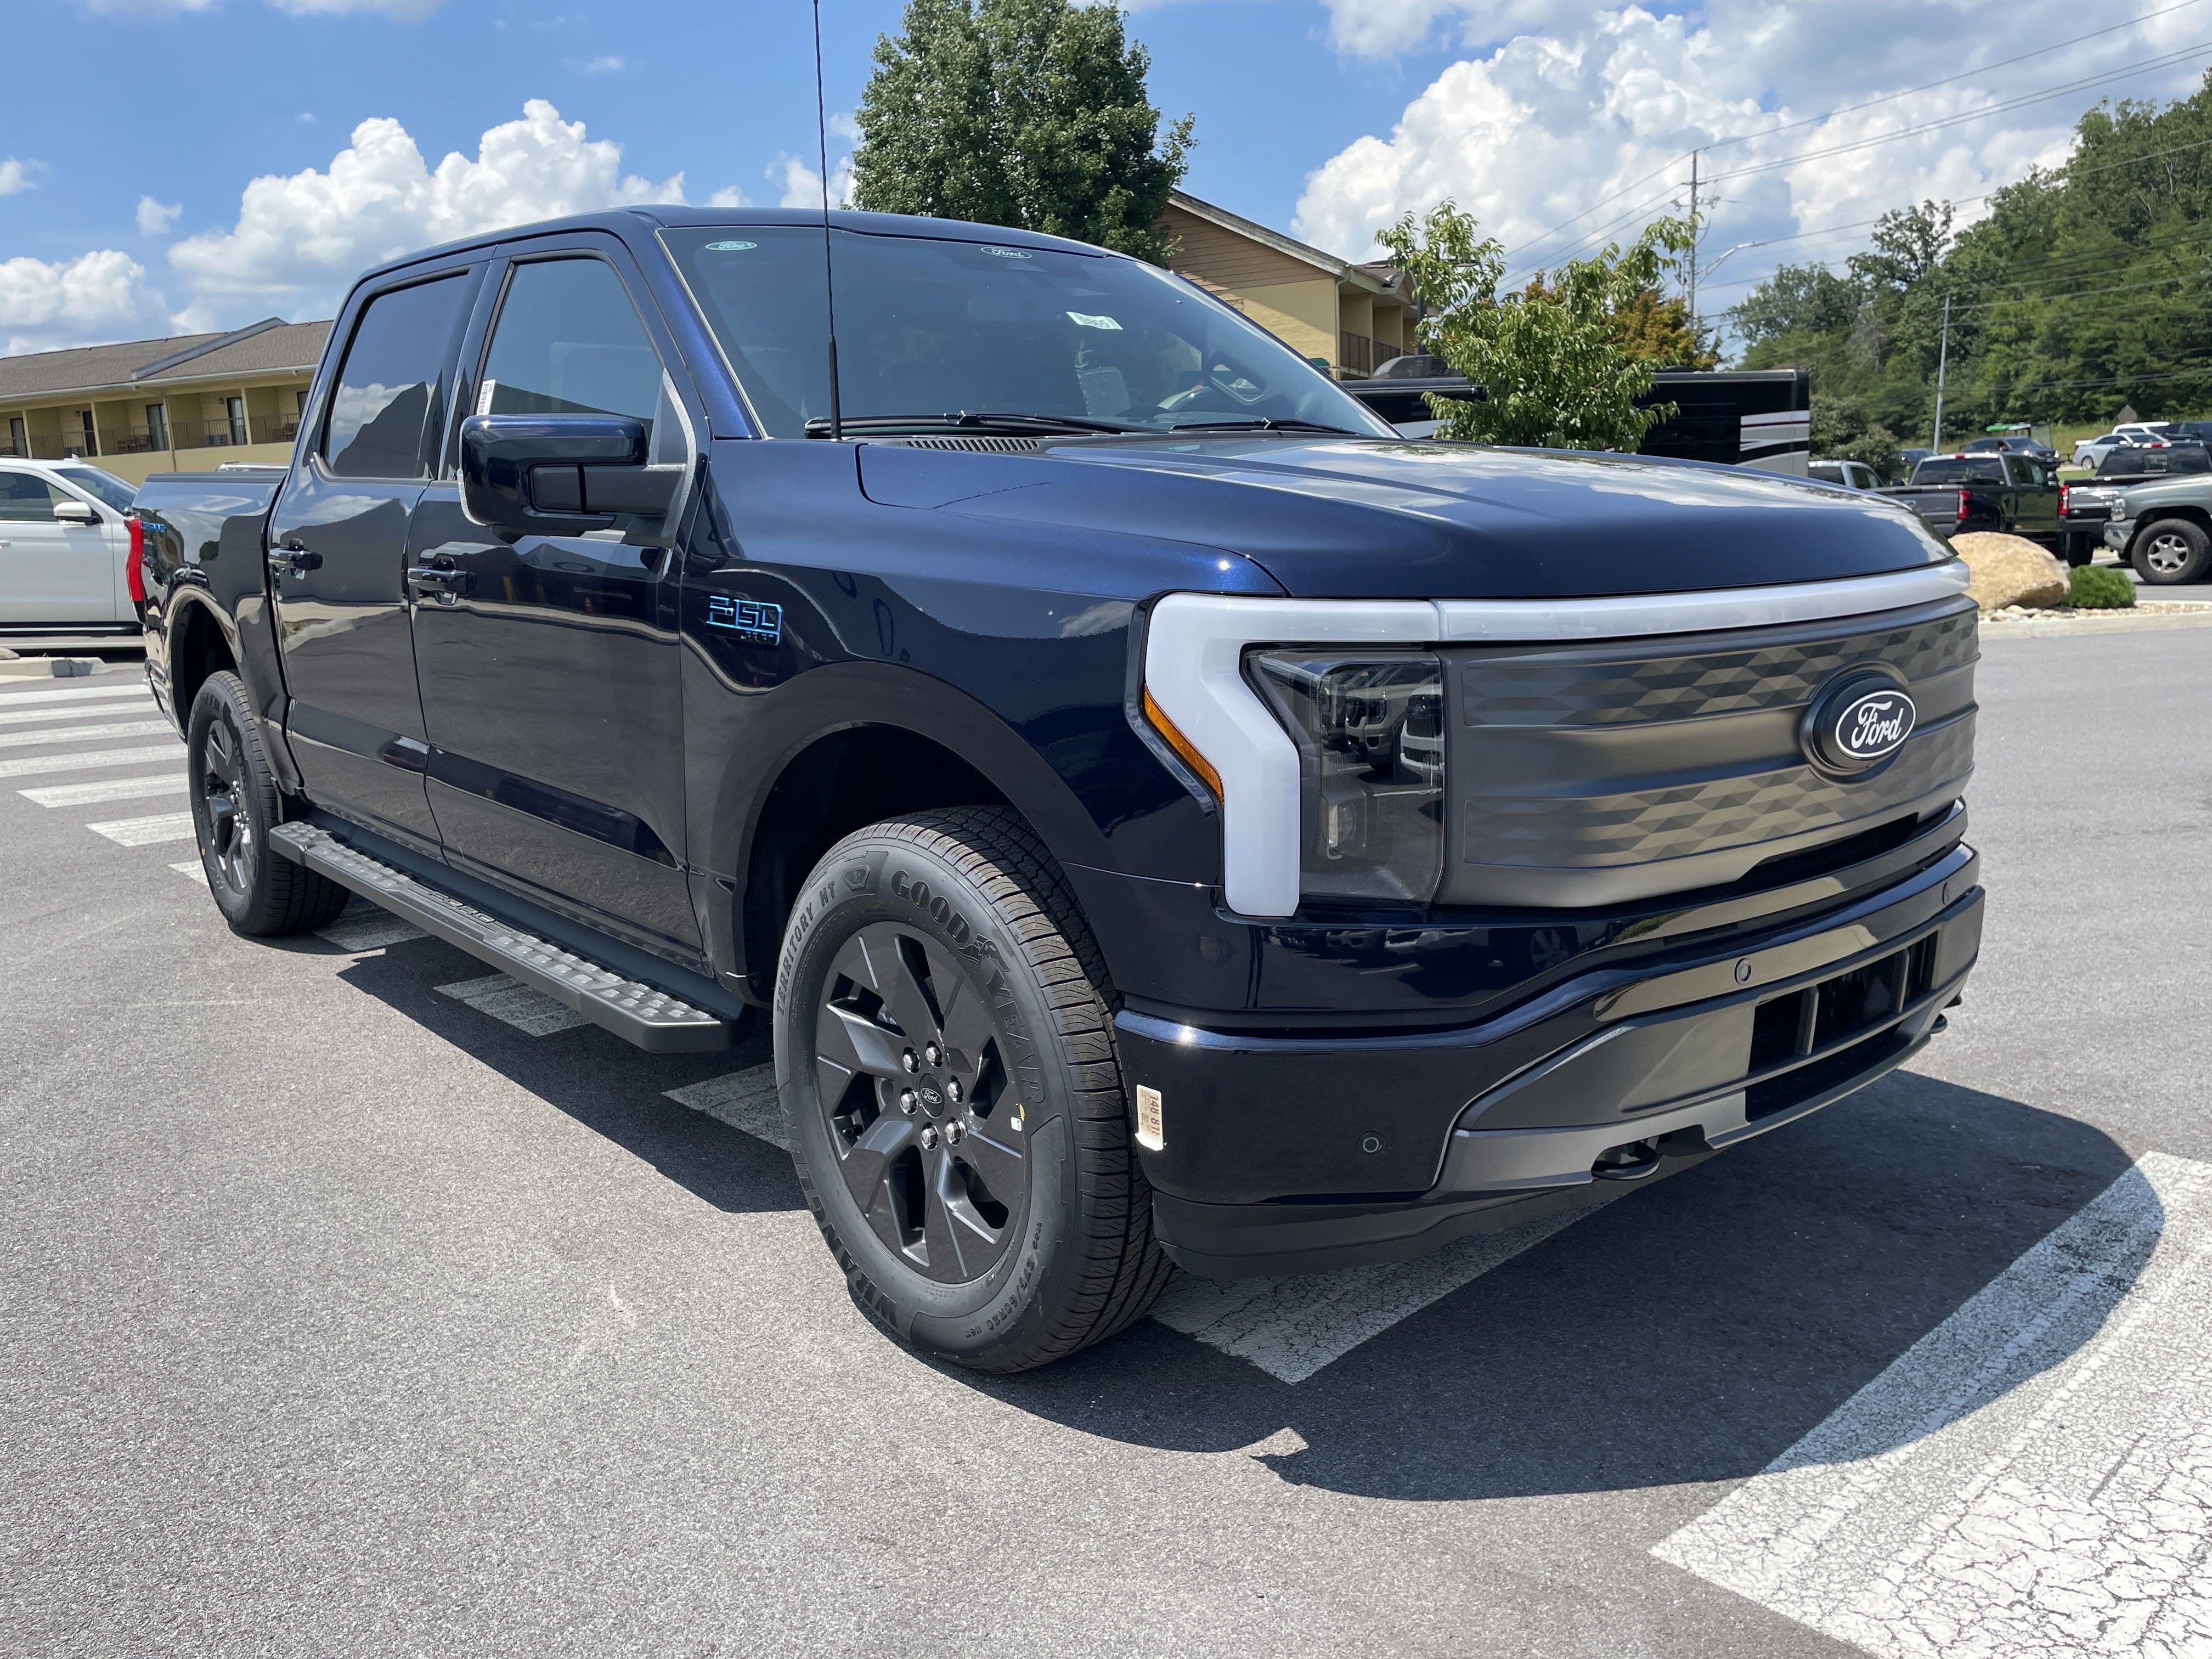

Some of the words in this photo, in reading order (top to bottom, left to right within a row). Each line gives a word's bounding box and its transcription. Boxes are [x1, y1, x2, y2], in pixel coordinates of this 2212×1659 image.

[1850, 700, 1904, 749] Ford
[777, 902, 814, 1016] TERRITORY
[819, 881, 836, 907] HT
[1149, 1095, 1159, 1115] 148
[783, 1108, 898, 1328] WRANGLER
